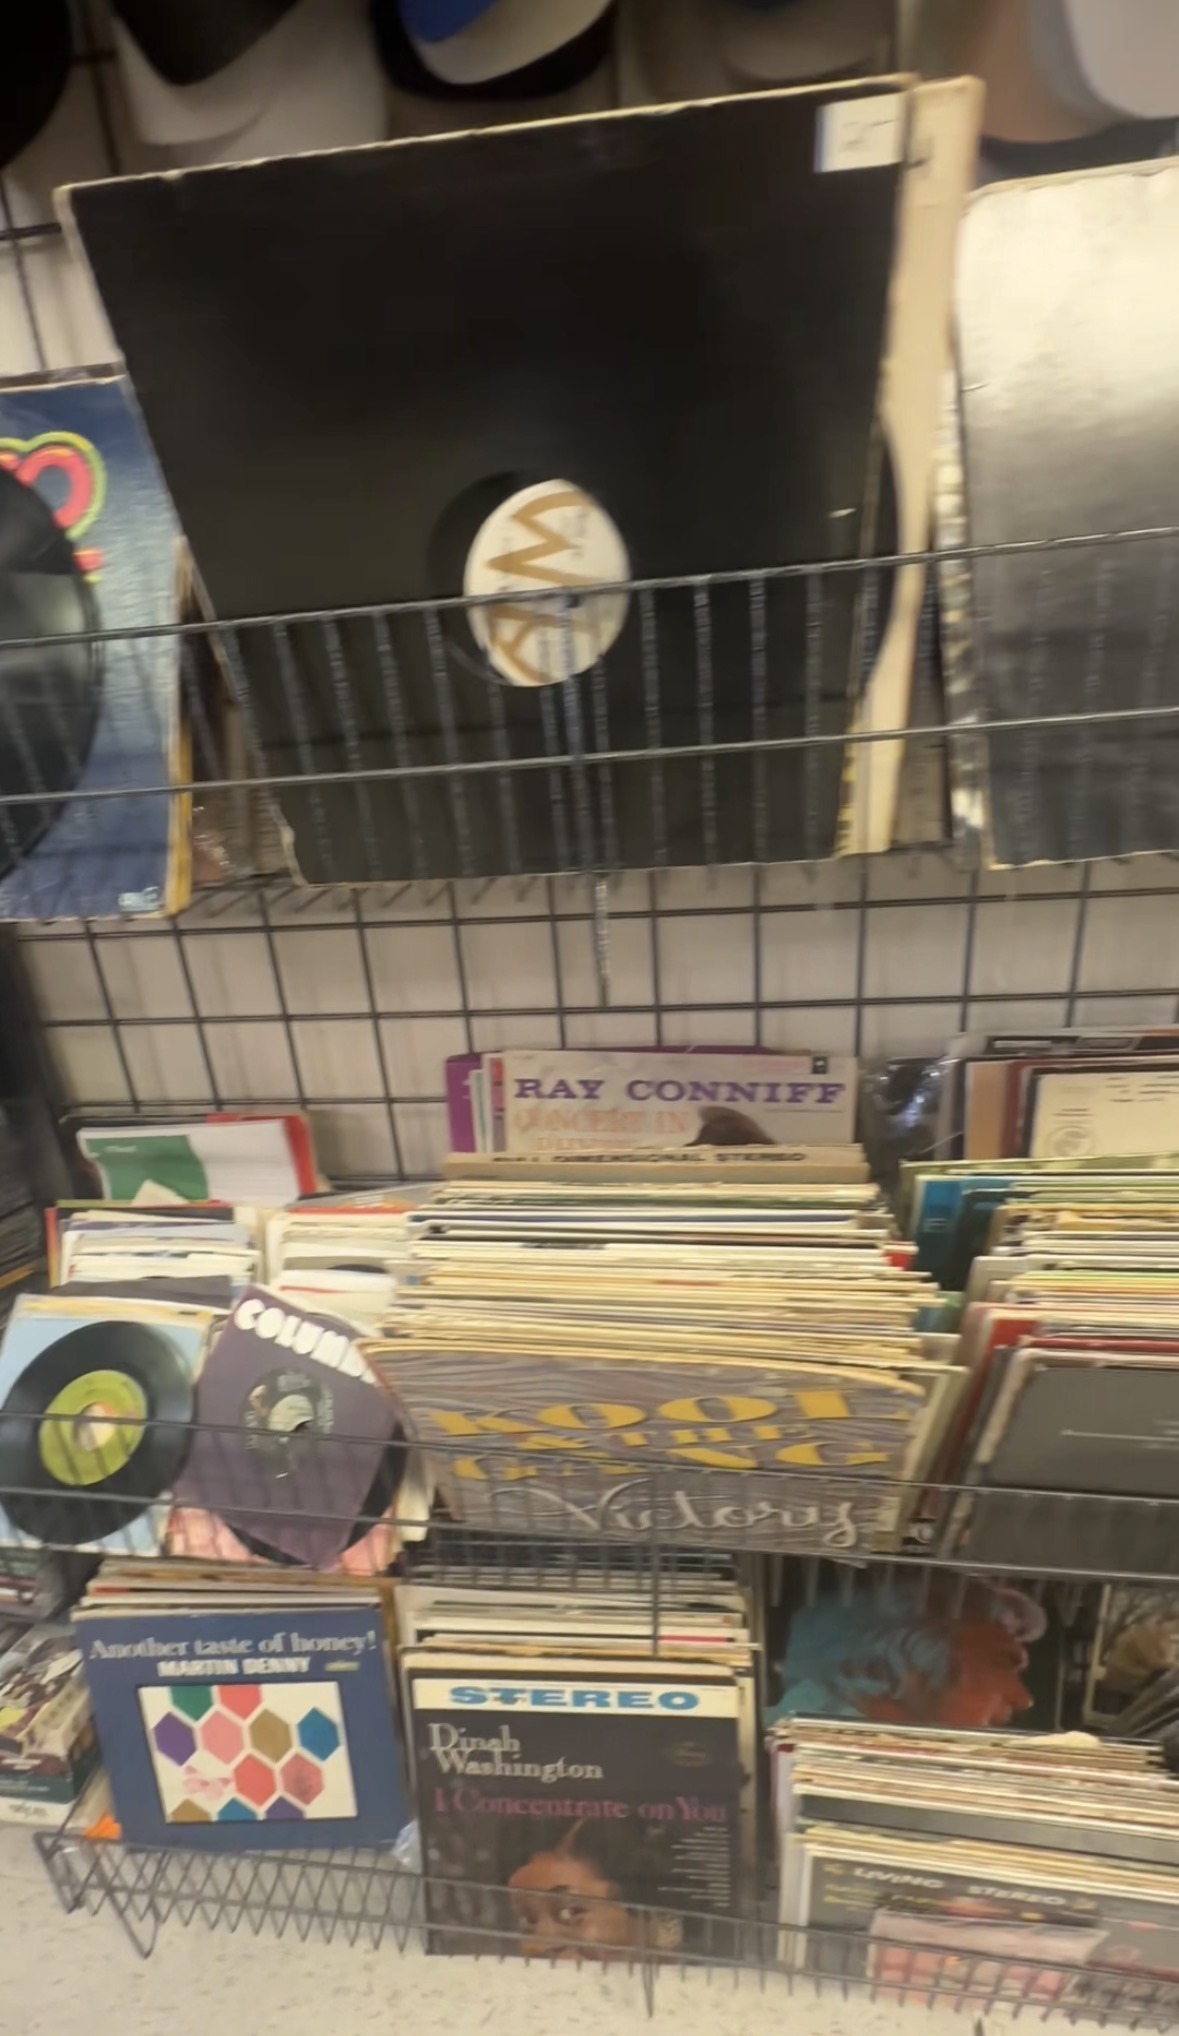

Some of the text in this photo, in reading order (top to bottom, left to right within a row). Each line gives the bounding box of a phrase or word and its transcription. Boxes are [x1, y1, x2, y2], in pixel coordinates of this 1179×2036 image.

[514, 1078, 846, 1104] RAY CONNIFF
[233, 1298, 377, 1385] COLUMB
[427, 1390, 911, 1438] KOOL
[488, 1478, 858, 1548] Victory
[89, 1629, 377, 1659] Another taste of honey!
[156, 1658, 239, 1677] MARTIN
[242, 1656, 311, 1675] DENNY
[449, 1686, 701, 1711] STEREO
[428, 1722, 521, 1751] Dinah
[434, 1748, 604, 1783] Washington
[435, 1786, 728, 1822] I Concentrate on You
[853, 1867, 946, 1889] LIVING
[967, 1885, 1067, 1905] STEREO
